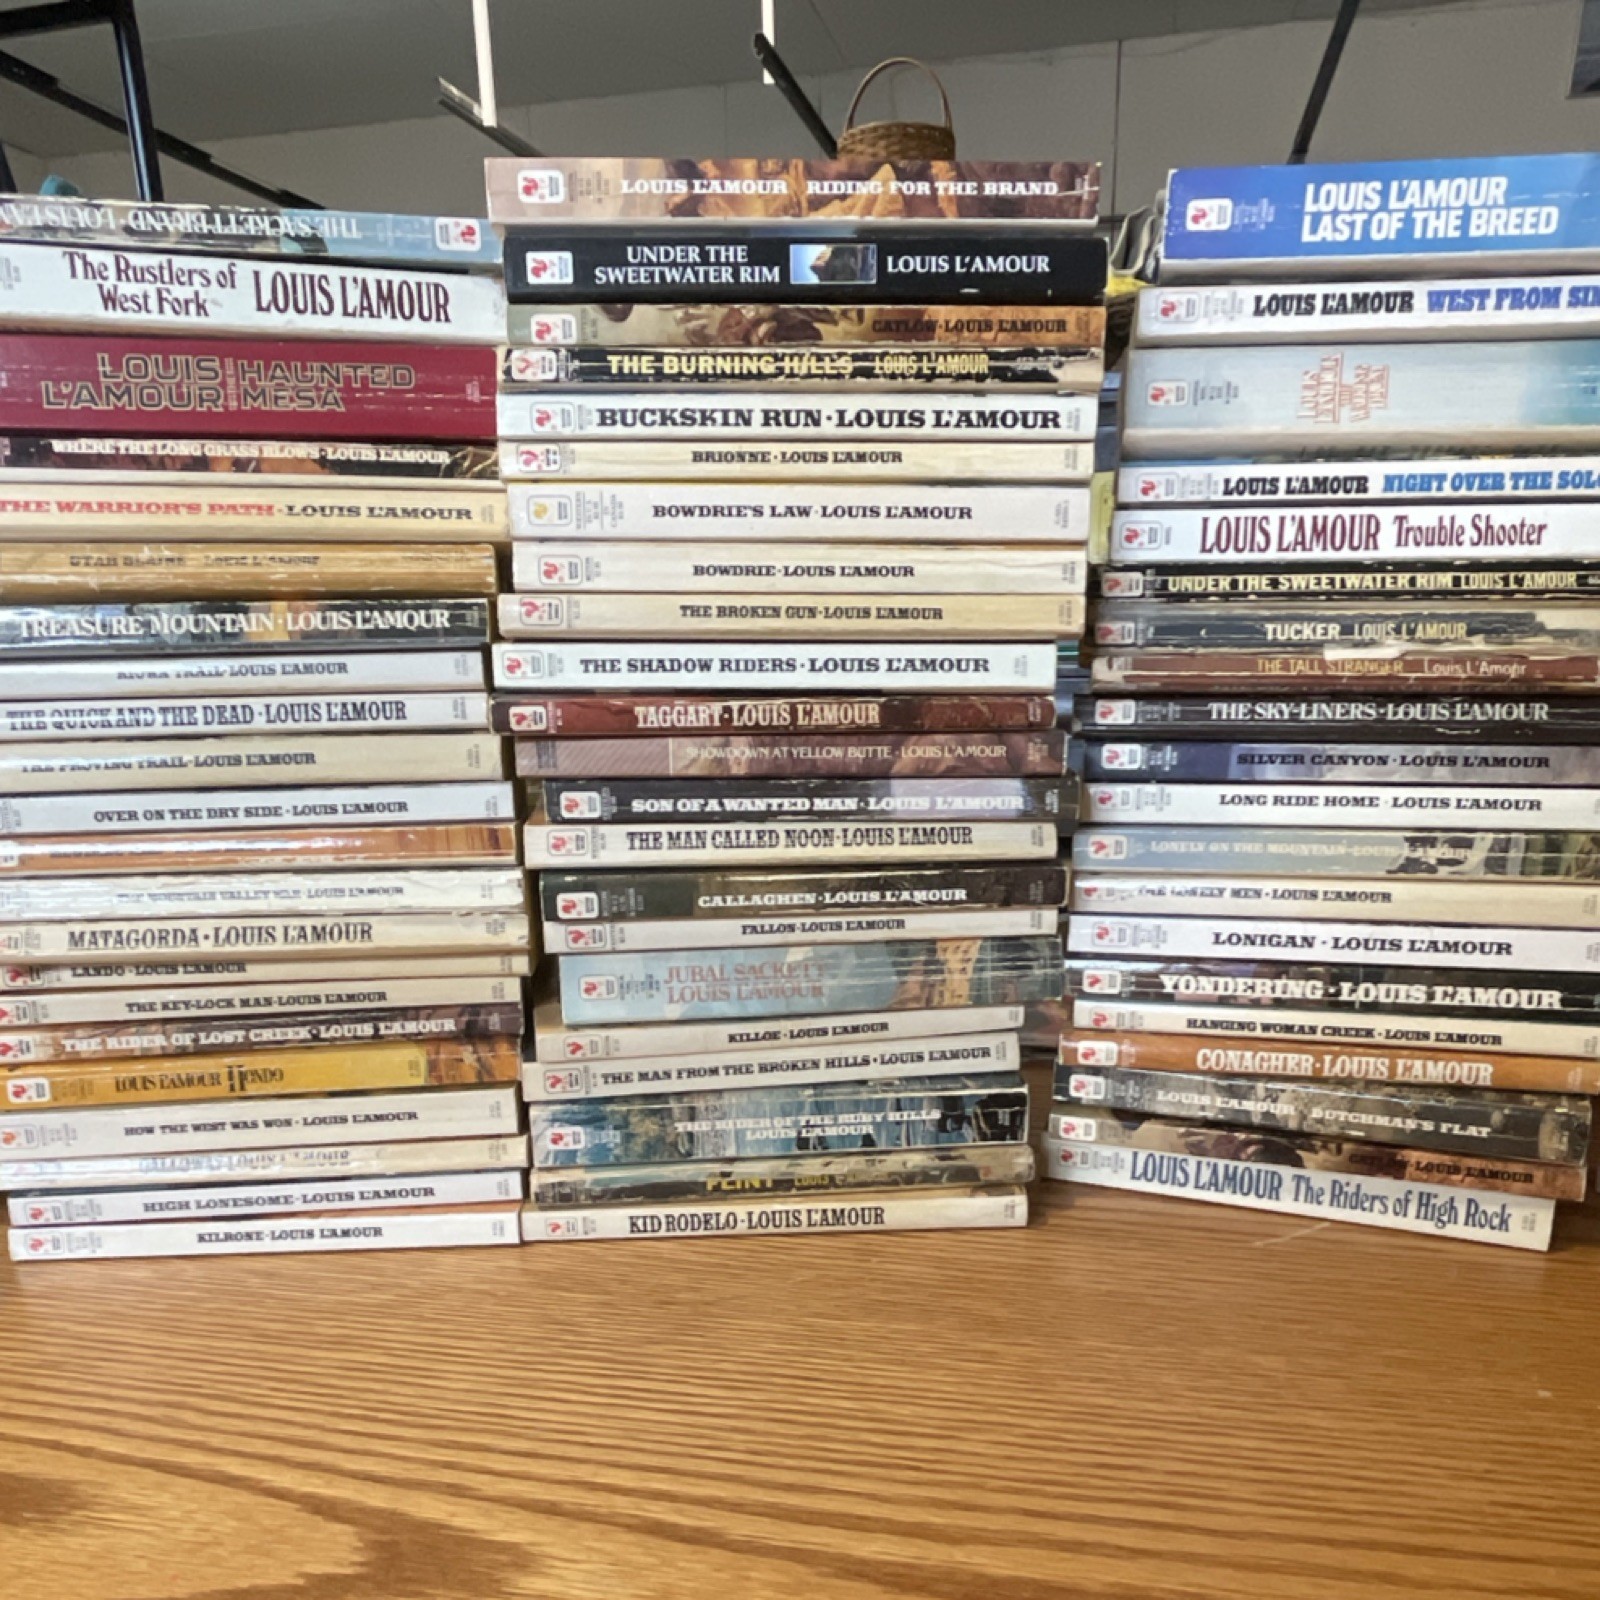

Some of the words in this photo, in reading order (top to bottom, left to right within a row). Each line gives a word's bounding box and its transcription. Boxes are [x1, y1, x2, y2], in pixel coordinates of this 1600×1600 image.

[620, 180, 686, 195] LOUIS
[695, 180, 786, 195] L'AMOUR
[807, 181, 884, 195] RIDING
[891, 181, 930, 195] FOR
[938, 181, 977, 195] THE
[984, 182, 1058, 196] BRAND
[1305, 180, 1381, 212] LOUIS
[1387, 177, 1508, 209] L'AMOUR
[1302, 213, 1368, 243] LAST
[1370, 211, 1404, 240] OF
[1412, 209, 1463, 238] THE
[1469, 206, 1559, 237] BREED
[626, 245, 708, 264] UNDER
[715, 245, 748, 263] THE
[886, 255, 956, 273] LOUIS
[961, 256, 1050, 273] L'AMOUR
[63, 251, 109, 282] The
[115, 256, 210, 288] Rustlers
[215, 263, 236, 288] of
[594, 266, 735, 285] SWEETWATER
[740, 266, 780, 283] RIM
[98, 284, 151, 313] West
[156, 288, 208, 316] Fork
[253, 270, 334, 315] LOUIS
[340, 275, 451, 322] L'AMOUR
[1254, 294, 1315, 317] LOUIS
[1321, 290, 1414, 315] L'AMOUR
[1427, 289, 1489, 312] WEST
[1497, 286, 1561, 310] FROM
[97, 353, 221, 383] LOUIS
[240, 360, 414, 388] HAUNTED
[41, 380, 224, 412] L'AMOUR
[242, 386, 345, 412] MESA
[596, 408, 752, 428] BUCKSKIN
[760, 409, 822, 428] RUN
[835, 409, 924, 428] LOUIS
[932, 410, 1060, 429] L'AMOUR
[692, 451, 770, 464] BRIONNE
[780, 451, 828, 464] LOUIS
[832, 451, 902, 464] L'AMOUR
[1223, 477, 1279, 496] LOUIS
[1285, 475, 1368, 494] L'AMOUR
[1383, 474, 1448, 493] NIGHT
[1452, 473, 1506, 492] OVER
[1511, 472, 1552, 490] THE
[1557, 472, 1600, 490] SOL
[56, 503, 201, 515] WARRIOR'S
[201, 503, 275, 516] PATH
[286, 505, 361, 518] LOUIS
[366, 506, 472, 520] L'AMOUR
[652, 505, 764, 520] BOWDRIE'S
[770, 506, 812, 520] LAW
[821, 506, 880, 520] LOUIS
[886, 506, 972, 520] L'AMOUR
[1200, 515, 1271, 555] LOUIS
[1277, 513, 1381, 553] L'AMOUR
[1393, 515, 1464, 549] Trouble
[1470, 515, 1547, 547] Shooter
[693, 566, 775, 578] BOWDRIE
[784, 566, 834, 578] LOUIS
[839, 566, 914, 578] L'AMOUR
[680, 604, 712, 618] THE
[718, 605, 782, 619] BROKEN
[786, 605, 818, 619] GUN
[826, 606, 871, 619] LOUIS
[876, 606, 943, 620] L'AMOUR
[18, 616, 144, 638] TREASURE
[150, 614, 275, 635] MOUNTAIN
[286, 610, 353, 631] LOUIS
[355, 609, 451, 629] L'AMOUR
[1265, 623, 1340, 640] TUCKER
[1354, 624, 1396, 639] LOUIS
[1401, 623, 1467, 639] L'AMOUR
[580, 658, 621, 674] THE
[626, 658, 713, 674] SHADOW
[718, 658, 797, 674] RIDERS
[808, 658, 880, 672] LOUIS
[886, 658, 989, 673] L'AMOUR
[635, 706, 722, 726] TAGGART
[730, 706, 790, 725] LOUIS
[797, 704, 880, 724] L'AMOUR
[1208, 703, 1254, 720] THE
[1259, 702, 1377, 721] SKY-LINERS
[1385, 703, 1448, 721] LOUIS
[1454, 702, 1549, 721] L'AMOUR
[1236, 753, 1306, 767] SILVER
[1311, 753, 1388, 767] CANYON
[1400, 753, 1457, 767] LOUIS
[1462, 754, 1549, 768] L'AMOUR
[94, 809, 139, 822] OVER
[143, 809, 165, 821] ON
[169, 808, 203, 820] THE
[207, 807, 240, 819] DRY
[244, 805, 282, 817] SIDE
[293, 803, 338, 816] LOUIS
[342, 801, 408, 814] L'AMOUR
[1219, 793, 1268, 806] LONG
[1272, 793, 1319, 807] RIDE
[1325, 795, 1379, 807] HOME
[1392, 796, 1450, 809] LOUIS
[1455, 797, 1542, 811] L'AMOUR
[626, 832, 662, 852] THE
[667, 831, 706, 850] MAN
[712, 830, 780, 849] CALLED
[784, 829, 832, 848] NOON
[842, 828, 894, 846] LOUIS
[899, 826, 973, 846] L'AMOUR
[698, 891, 816, 908] CALLAGHEN
[823, 890, 877, 904] LOUIS
[883, 888, 967, 902] L'AMOUR
[68, 928, 198, 949] MATAGORDA
[213, 926, 276, 946] LOUIS
[283, 923, 373, 944] L'AMOUR
[1212, 933, 1315, 948] LONIGAN
[1331, 936, 1402, 952] LOUIS
[1408, 940, 1513, 956] L'AMOUR
[126, 1002, 158, 1013] THE
[162, 999, 235, 1012] KEY-LOCK
[239, 998, 271, 1008] MAN
[279, 995, 320, 1006] LOUIS
[325, 992, 387, 1005] L'AMOUR
[1160, 974, 1323, 999] YONDERING
[1341, 984, 1427, 1005] LOUIS
[1432, 985, 1562, 1009] L'AMOUR
[728, 1031, 778, 1043] KILLOE
[789, 1027, 829, 1039] LOUIS
[832, 1023, 889, 1036] L'AMOUR
[1197, 1049, 1312, 1076] CONAGHER
[1324, 1056, 1389, 1081] LOUIS
[1396, 1060, 1493, 1085] L'AMOUR
[143, 1199, 189, 1212] HIGH
[195, 1194, 293, 1210] LONESOME
[301, 1190, 354, 1203] LOUIS
[359, 1186, 435, 1200] L'AMOUR
[1131, 1151, 1190, 1188] LOUIS
[1194, 1158, 1281, 1201] L'AMOUR
[1292, 1174, 1325, 1206] The
[1330, 1180, 1389, 1215] Riders
[1393, 1189, 1413, 1217] of
[1416, 1192, 1460, 1229] High
[1465, 1197, 1511, 1232] Rock
[630, 1213, 661, 1234] KID
[665, 1212, 738, 1232] RODELO
[747, 1210, 802, 1229] LOUIS
[807, 1207, 885, 1227] L'AMOUR
[197, 1231, 264, 1243] KILRONE
[270, 1228, 315, 1241] LOUIS
[319, 1226, 382, 1239] L'AMOUR
